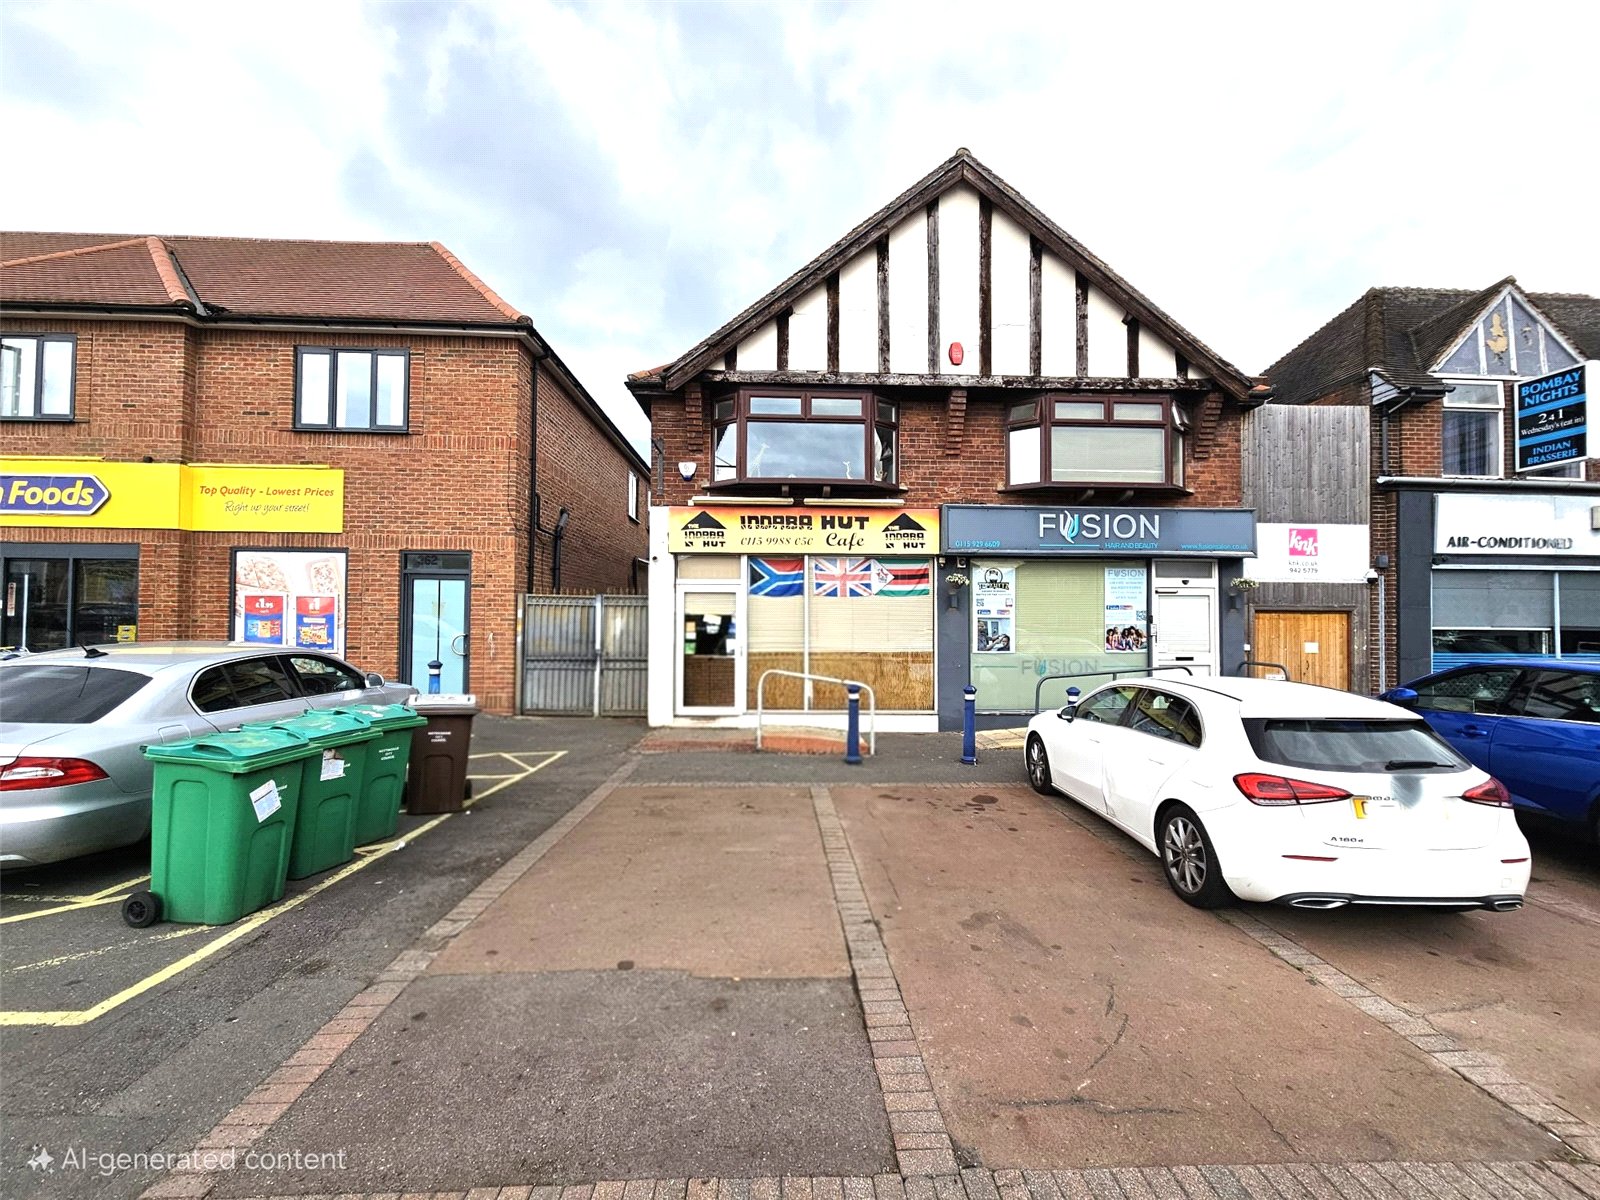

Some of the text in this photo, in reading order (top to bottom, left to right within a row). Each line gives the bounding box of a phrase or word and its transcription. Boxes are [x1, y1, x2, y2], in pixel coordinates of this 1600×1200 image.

[1521, 371, 1582, 396] BOMBAY
[1525, 383, 1579, 407] NIGHTS
[1521, 422, 1560, 436] Wednesday's
[1533, 440, 1571, 455] INDIAN
[1527, 448, 1578, 465] BRASSERIE
[8, 480, 94, 506] Foods
[200, 486, 218, 497] Top
[220, 486, 256, 498] Quality
[266, 487, 301, 496] Lowest
[304, 487, 335, 497] Prices
[225, 500, 248, 516] Right
[250, 505, 261, 515] up
[261, 504, 283, 516] your
[820, 515, 870, 530] HUT
[1039, 512, 1160, 541] FUSION
[826, 532, 865, 551] Cafe
[1290, 530, 1318, 556] knk
[1446, 536, 1574, 550] AIR-CONDITIONED
[1108, 569, 1145, 578] FUSION
[1022, 657, 1099, 676] FUSION
